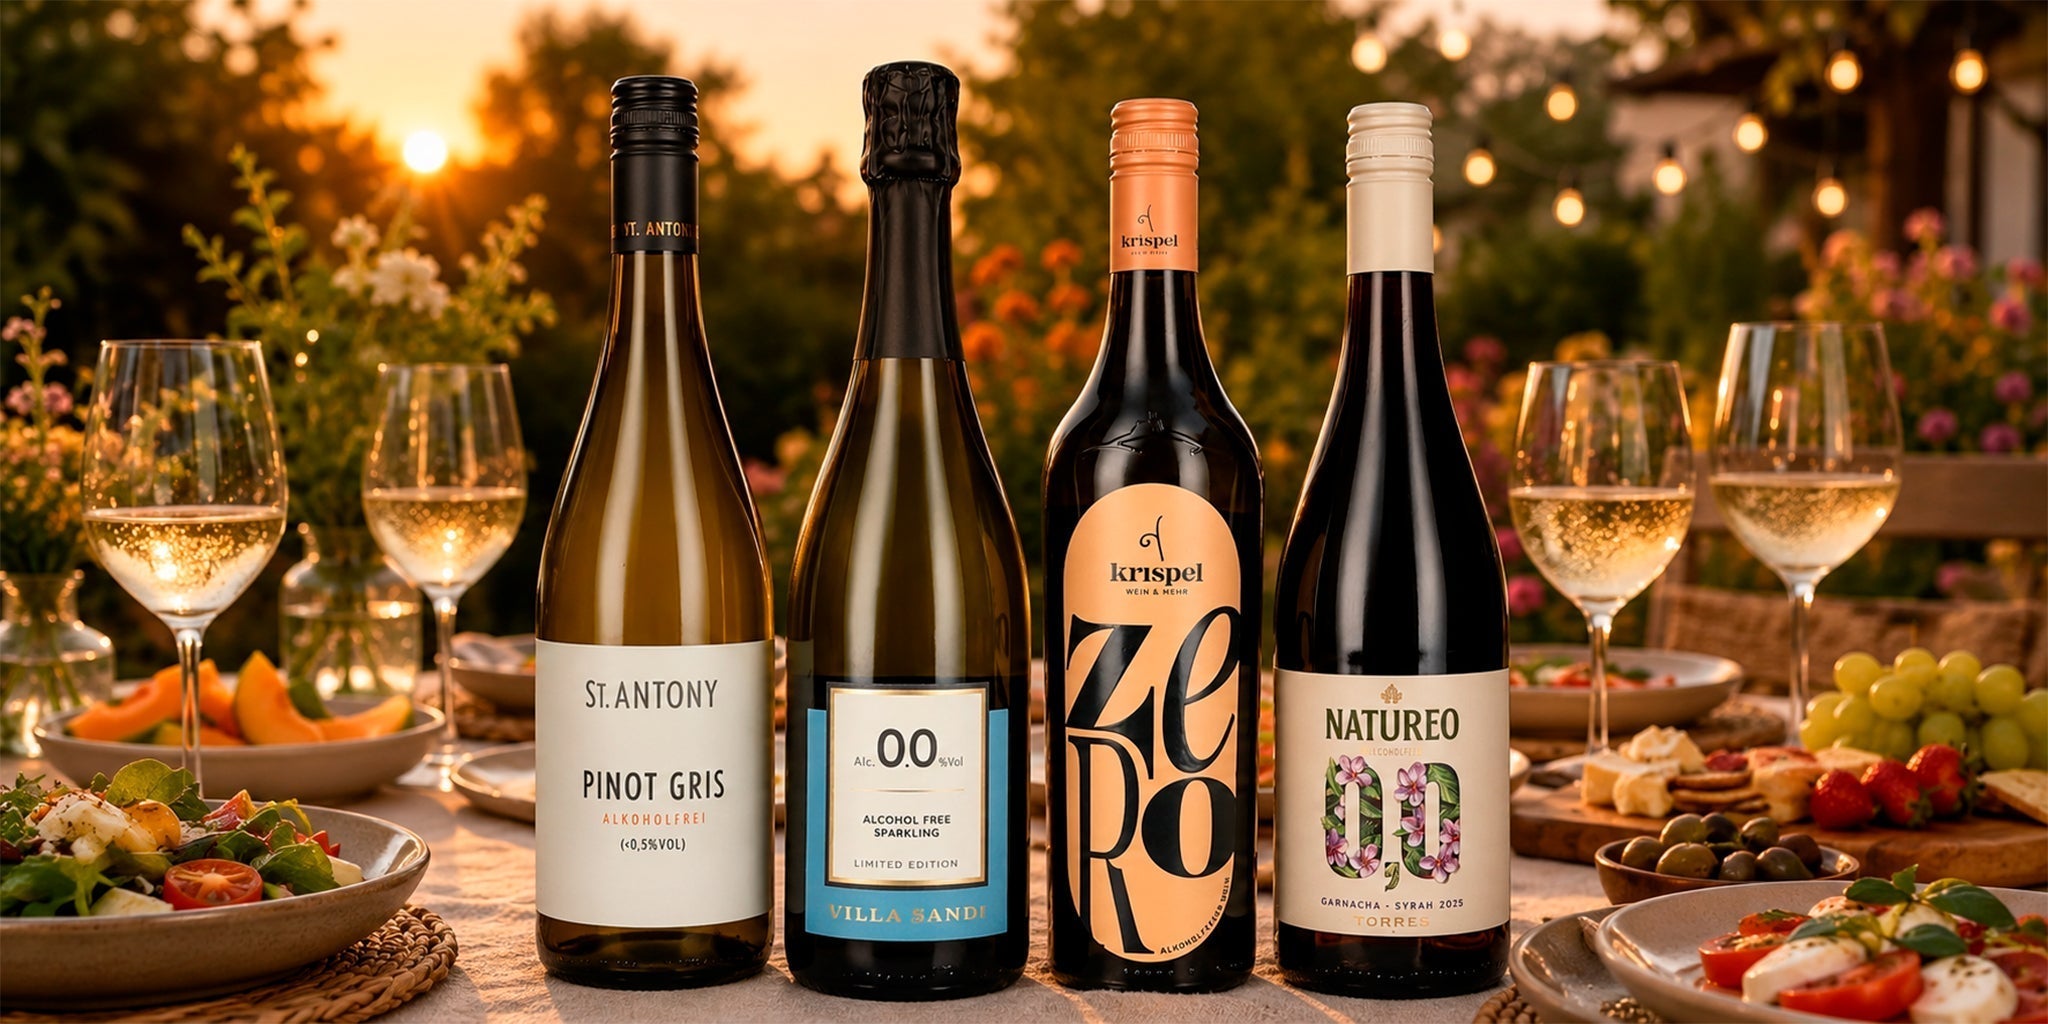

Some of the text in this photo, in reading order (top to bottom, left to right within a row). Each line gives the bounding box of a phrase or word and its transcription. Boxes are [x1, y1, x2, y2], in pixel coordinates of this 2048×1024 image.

[1122, 234, 1178, 249] krispel
[1110, 563, 1204, 586] krispel
[615, 680, 718, 708] ANTONY
[1326, 708, 1459, 741] NATUREO
[854, 728, 963, 768] Alc. 0.0 %Vol
[583, 770, 725, 800] PINOT GRIS
[602, 813, 706, 826] ALKOHOLFREI
[862, 815, 951, 825] ALCOHOL FREE
[874, 828, 940, 838] SPARKLING
[620, 838, 686, 851] (<0,5%VOL)
[854, 859, 958, 869] LIMITED EDITION
[1321, 897, 1380, 909] GARNACHA
[1395, 901, 1433, 910] SYRAH
[1439, 899, 1463, 908] 2025
[830, 904, 901, 922] VILLA
[1354, 915, 1430, 928] TORRES
